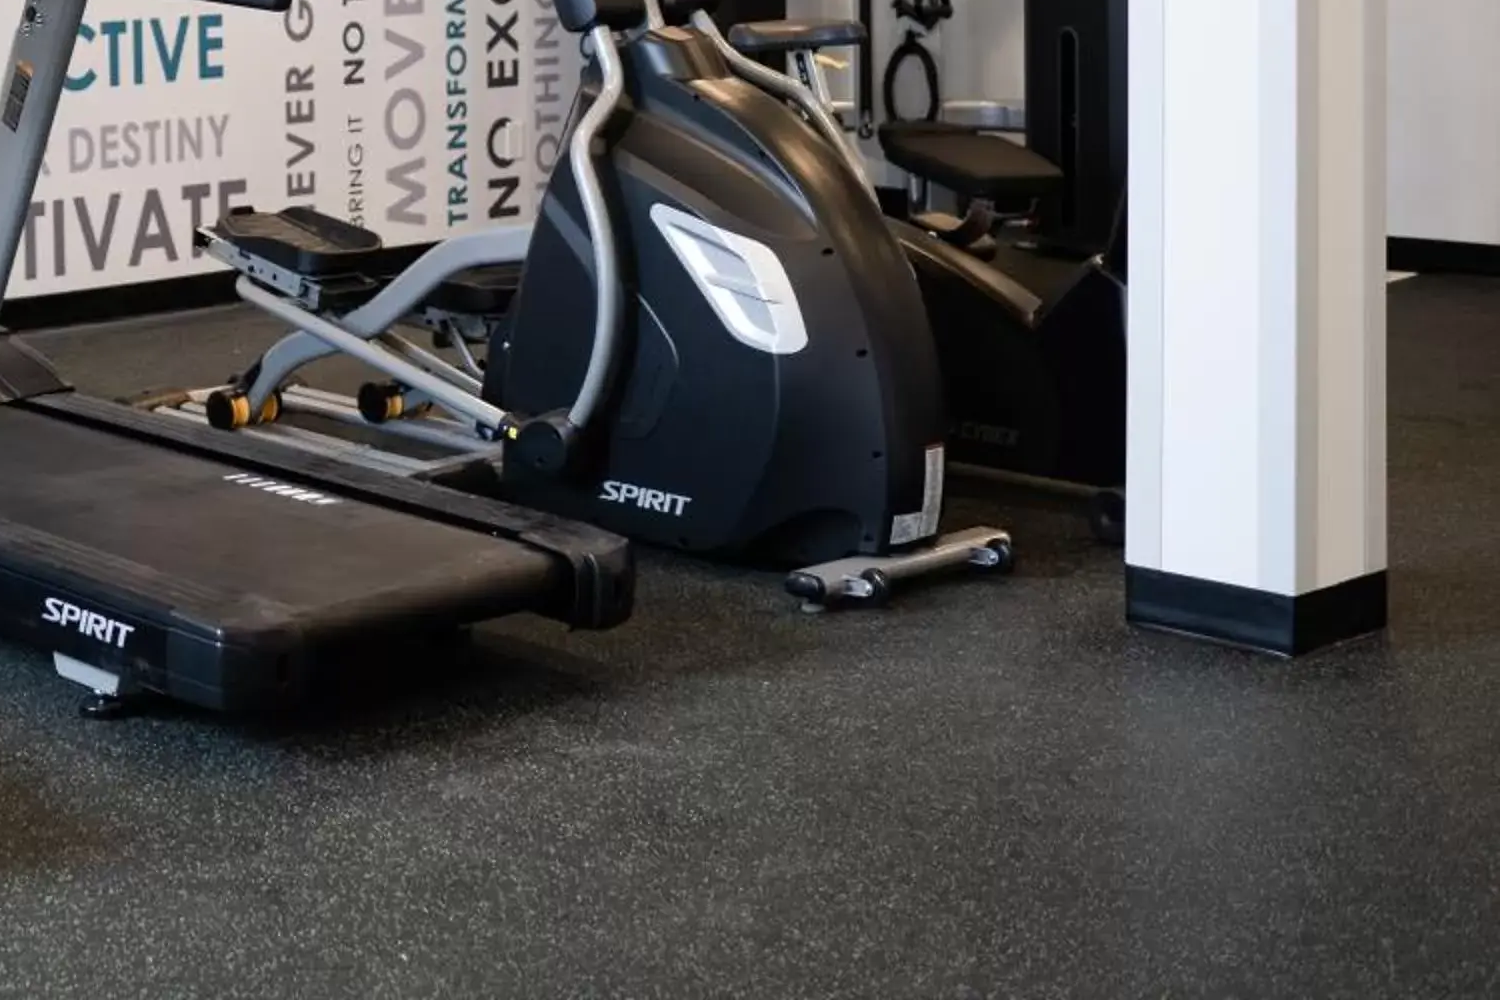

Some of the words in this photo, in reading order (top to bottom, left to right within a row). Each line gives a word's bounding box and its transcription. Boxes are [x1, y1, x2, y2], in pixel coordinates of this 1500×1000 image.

[63, 14, 224, 92] CTIVE
[342, 20, 365, 86] NO
[68, 114, 230, 174] DESTINY
[285, 64, 317, 210] EVER
[348, 115, 364, 134] IT
[486, 117, 520, 219] NO
[600, 480, 692, 517] SPIRIT
[41, 597, 135, 649] SPIRIT
